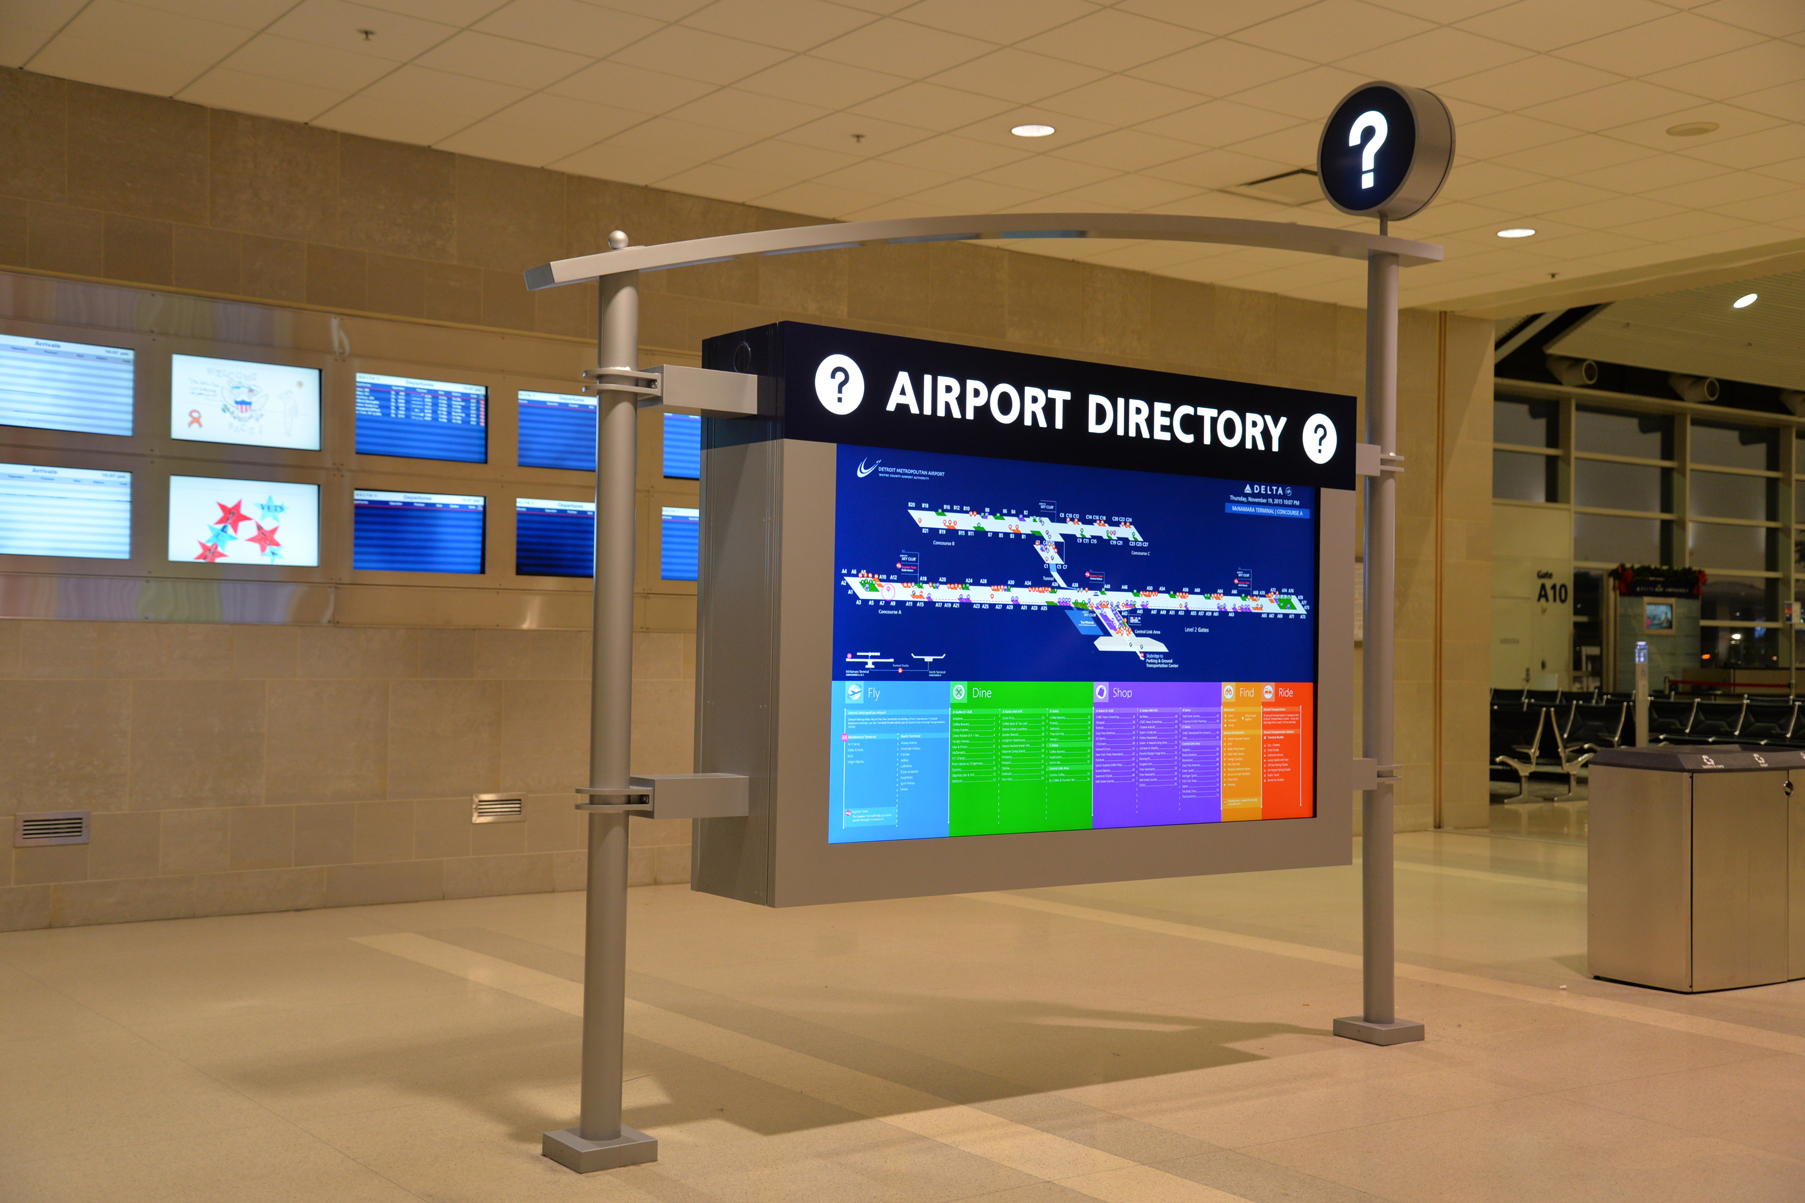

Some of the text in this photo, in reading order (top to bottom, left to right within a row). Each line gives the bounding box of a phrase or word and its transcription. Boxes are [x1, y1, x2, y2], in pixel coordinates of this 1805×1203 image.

[206, 367, 258, 380] WELCOME
[886, 371, 1071, 429] AIRPORT
[1088, 393, 1287, 452] DIRECTORY
[1254, 485, 1283, 495] DELTA
[260, 504, 284, 513] VETS
[1537, 570, 1553, 580] Gate
[1537, 583, 1568, 603] A10
[868, 687, 880, 701] Fly
[972, 687, 992, 698] Dine
[1112, 687, 1132, 699] Shop
[1240, 687, 1254, 697] Find
[1279, 688, 1294, 697] Ride
